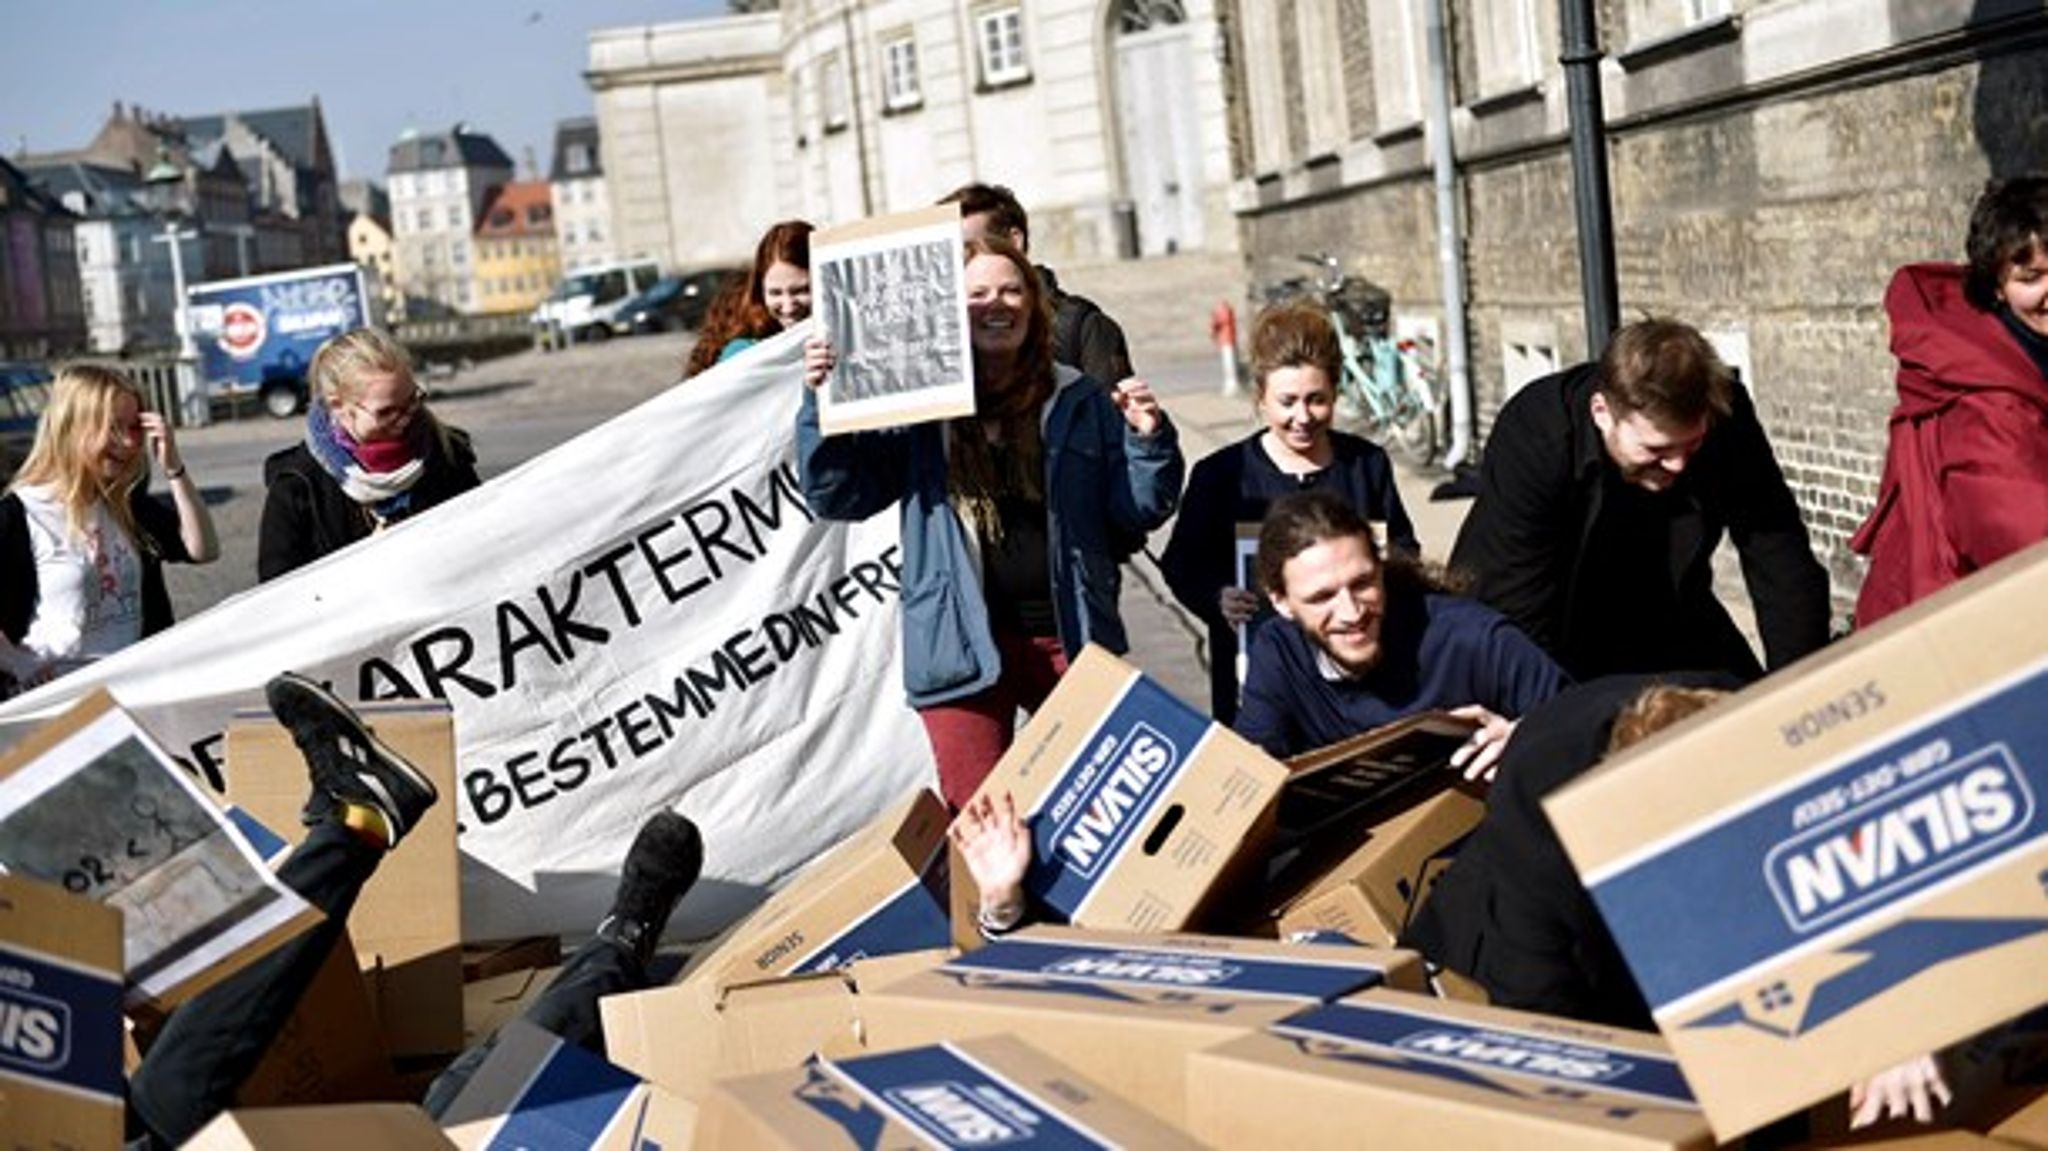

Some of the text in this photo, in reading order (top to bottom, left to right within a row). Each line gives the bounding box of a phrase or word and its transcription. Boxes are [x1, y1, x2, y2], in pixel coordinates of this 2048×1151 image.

[322, 462, 814, 701] ARAKTERM
[464, 627, 776, 823] BESTEMME
[1781, 680, 1886, 748] SENIOR
[1062, 735, 1168, 868] SILVAN
[1786, 766, 2016, 915] SILVAN
[0, 1002, 59, 1060] SI
